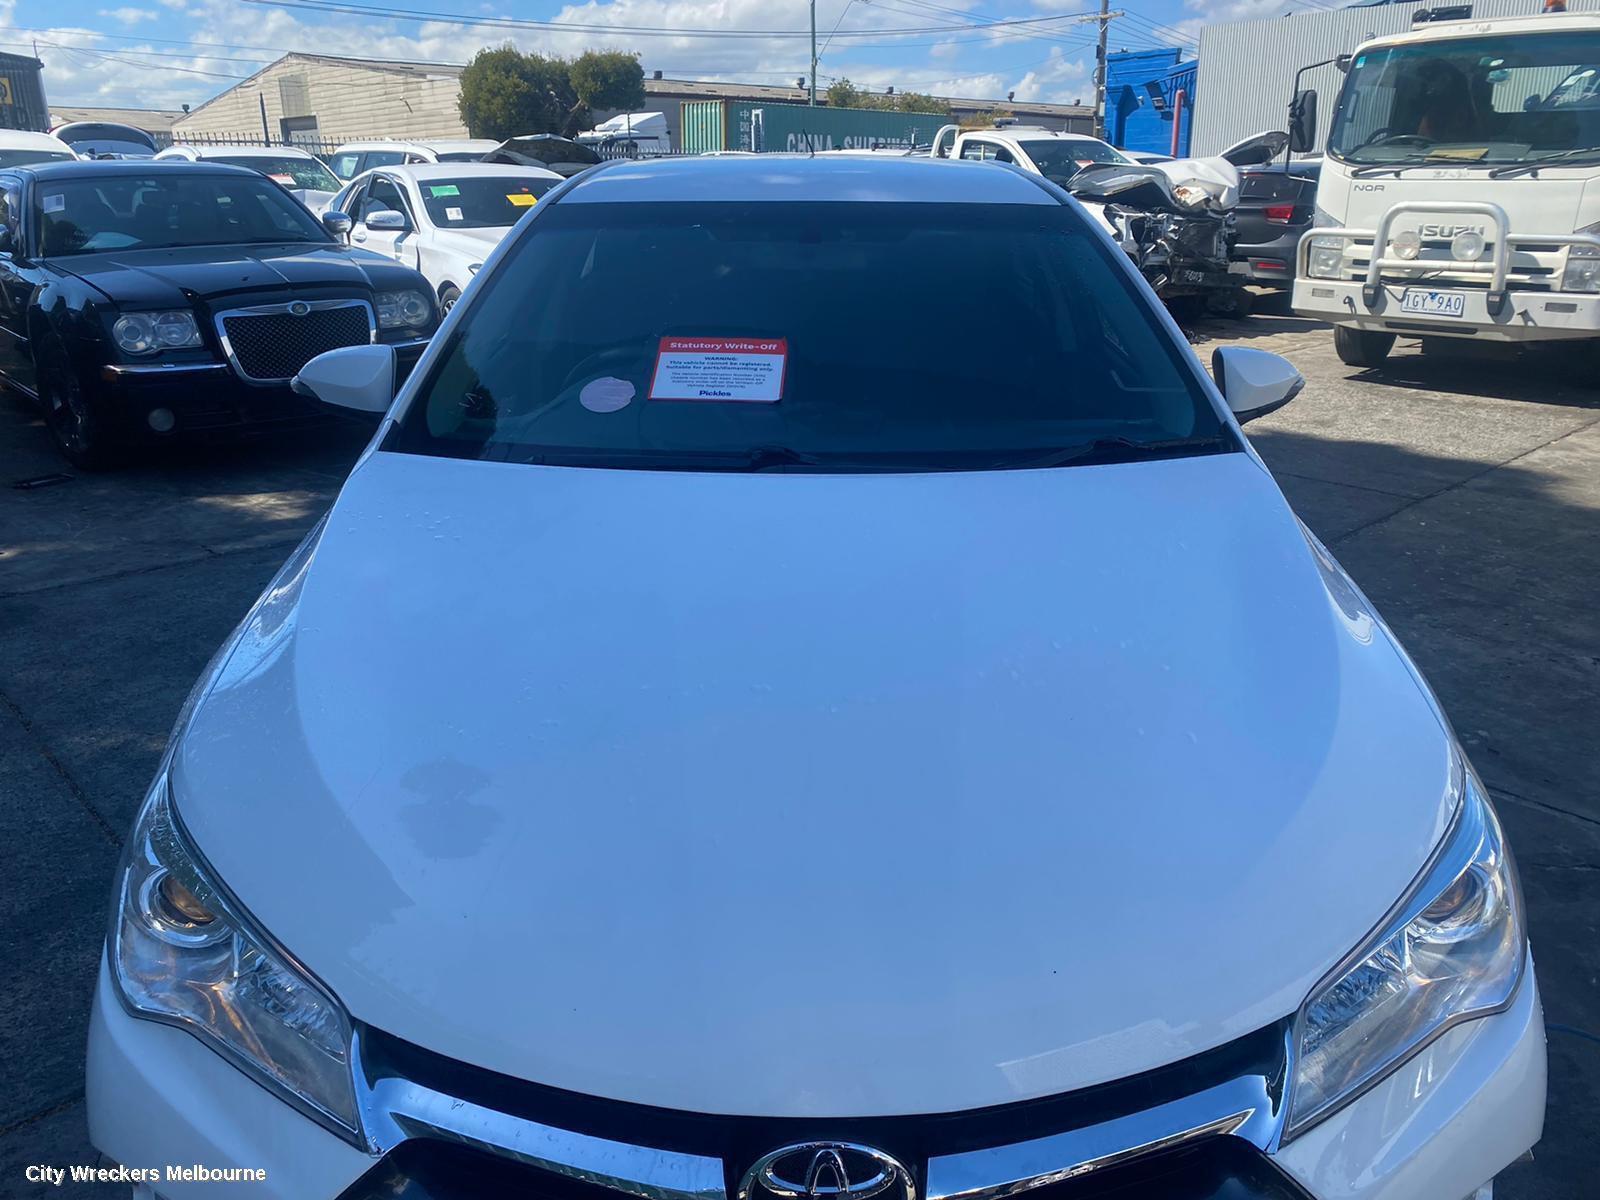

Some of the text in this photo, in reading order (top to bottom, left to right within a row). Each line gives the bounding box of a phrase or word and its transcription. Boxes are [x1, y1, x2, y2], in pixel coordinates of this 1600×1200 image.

[787, 132, 833, 152] CHINA
[1418, 224, 1485, 237] ISUZU
[1406, 293, 1428, 308] 1GY
[670, 342, 722, 350] Statutory
